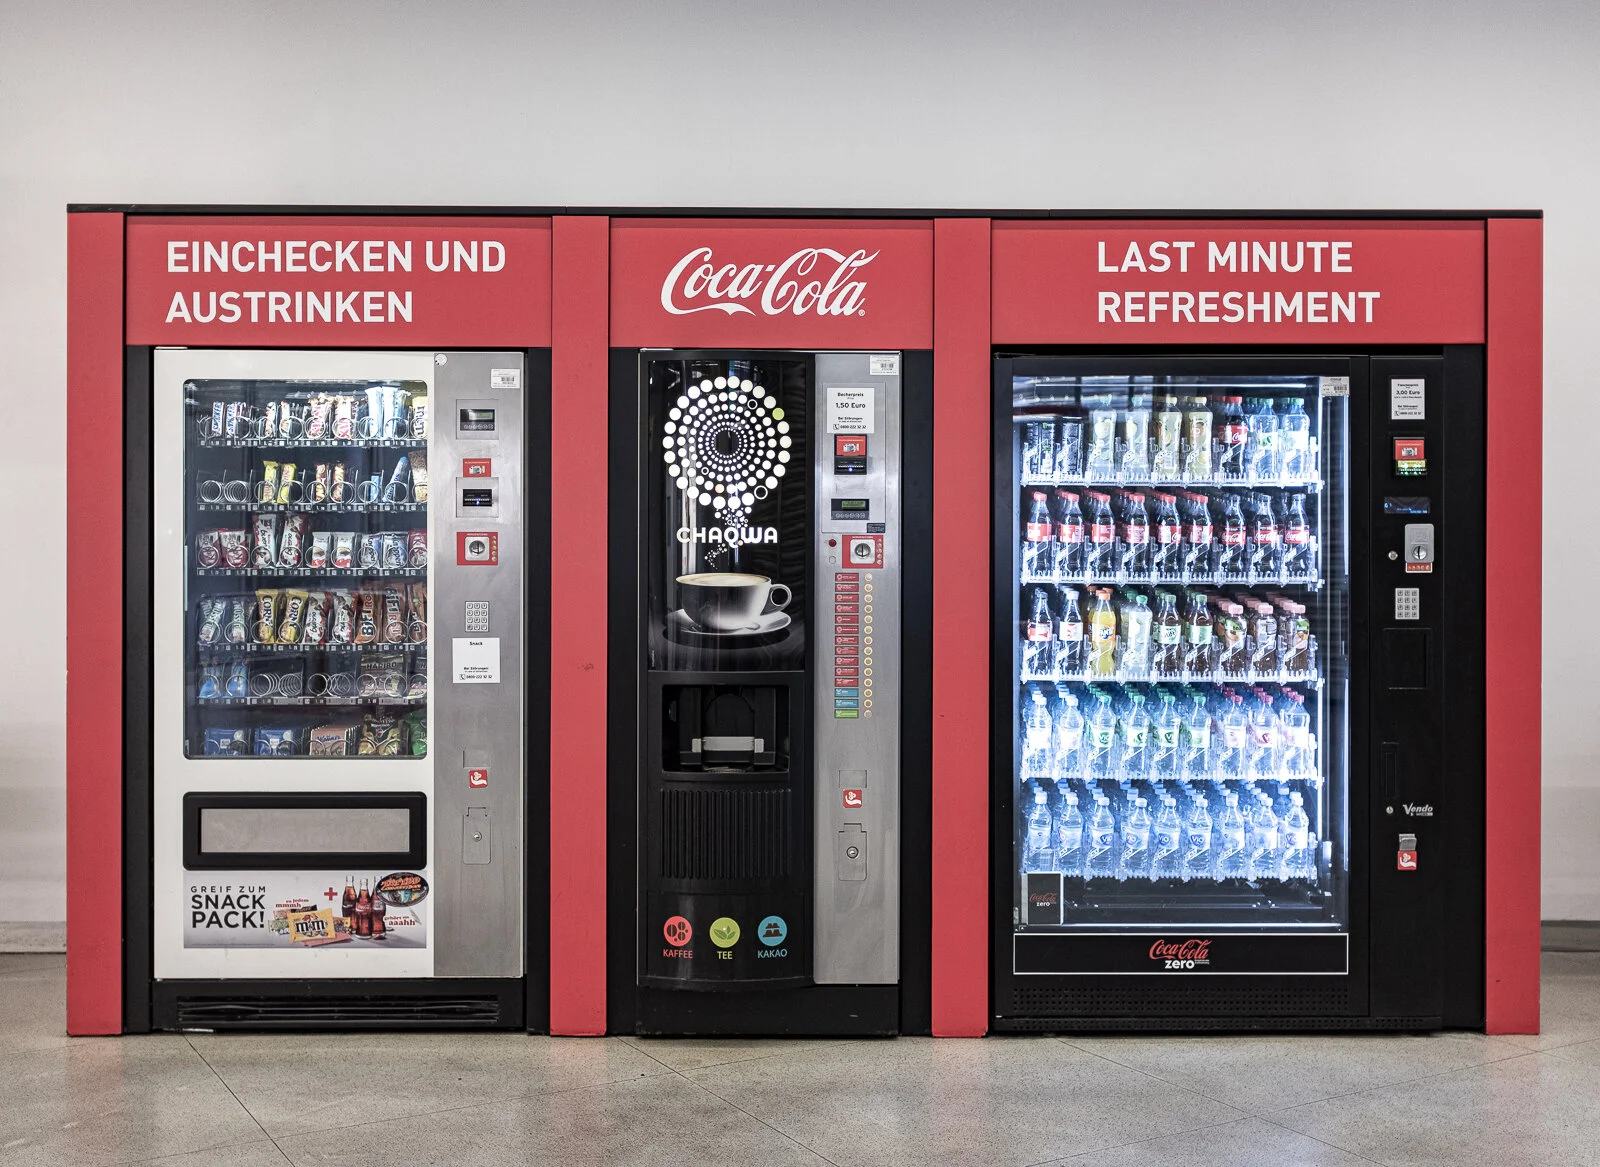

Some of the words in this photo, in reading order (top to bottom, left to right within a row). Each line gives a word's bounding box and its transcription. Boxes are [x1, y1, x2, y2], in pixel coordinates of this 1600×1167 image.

[166, 241, 413, 273] EINCHECKEN
[425, 241, 506, 273] UND
[1097, 241, 1195, 273] LAST
[1207, 241, 1353, 273] MINUTE
[661, 247, 880, 316] Coca-Cola
[165, 291, 413, 323] AUSTRINKEN
[1097, 292, 1381, 323] REFRESHMENT
[676, 522, 778, 549] CHAQWA
[1402, 803, 1434, 815] Vendo
[191, 894, 266, 909] SNACK
[192, 911, 265, 928] PACK!
[663, 949, 693, 959] KAFFEE
[716, 951, 733, 960] TEE
[757, 948, 788, 959] KAKAO
[1149, 939, 1212, 960] Coca-Cola
[1164, 960, 1195, 969] zero
